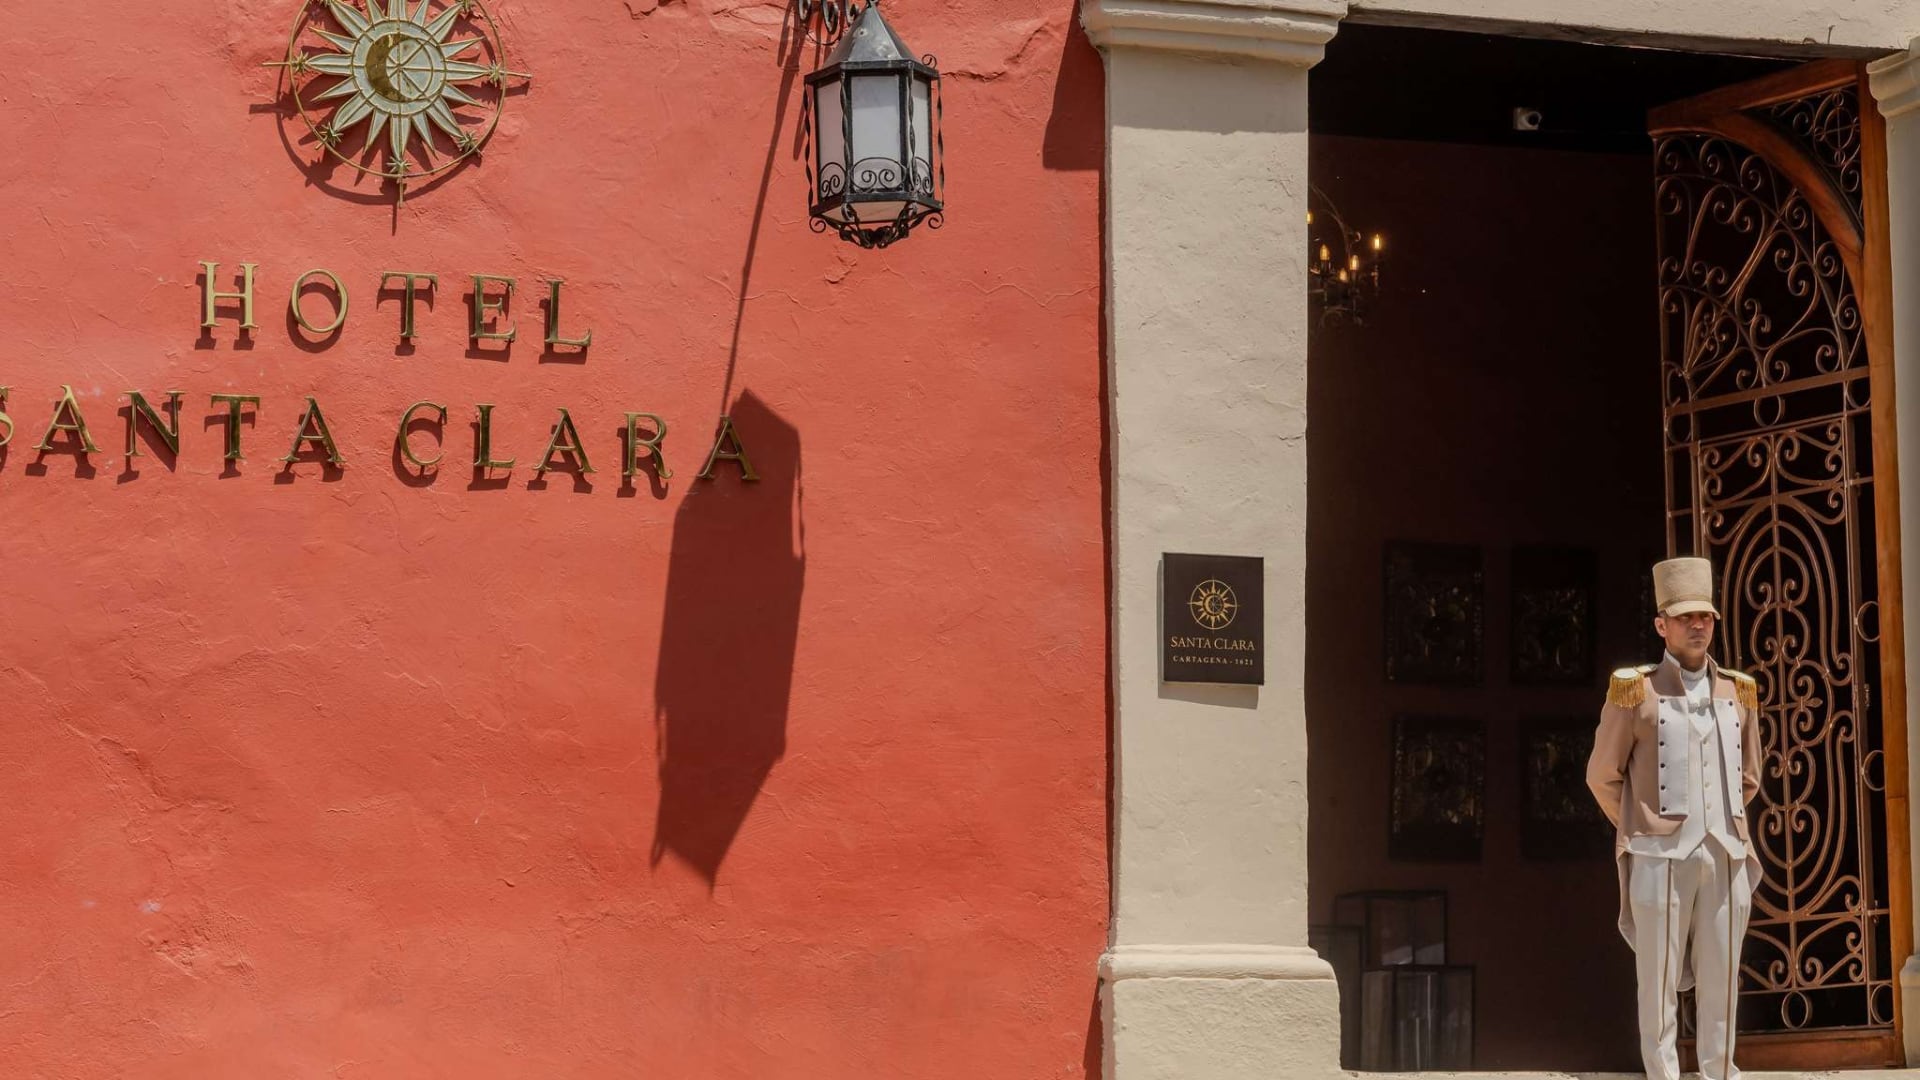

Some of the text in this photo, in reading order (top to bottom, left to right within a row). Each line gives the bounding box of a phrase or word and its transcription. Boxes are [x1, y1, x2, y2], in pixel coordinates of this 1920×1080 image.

[199, 261, 592, 347] HOTEL
[400, 401, 760, 480] CLARA
[1170, 636, 1255, 651] SANTA CLARA
[1172, 655, 1228, 665] CARTAGENA
